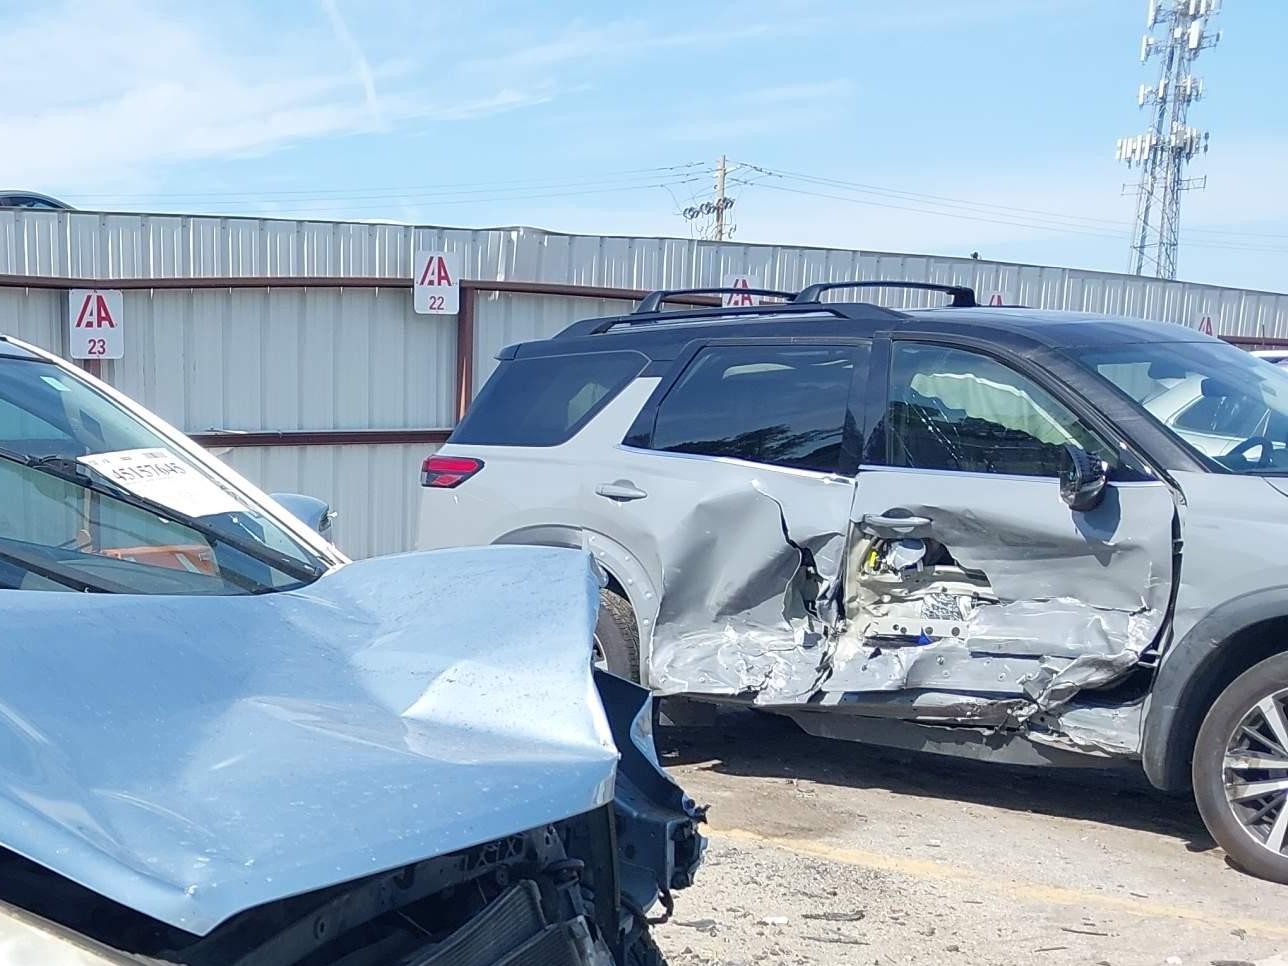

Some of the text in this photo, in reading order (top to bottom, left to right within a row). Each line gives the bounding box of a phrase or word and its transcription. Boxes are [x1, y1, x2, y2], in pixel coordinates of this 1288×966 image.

[429, 295, 445, 311] 22
[87, 338, 106, 355] 23
[112, 462, 187, 481] 45157645
